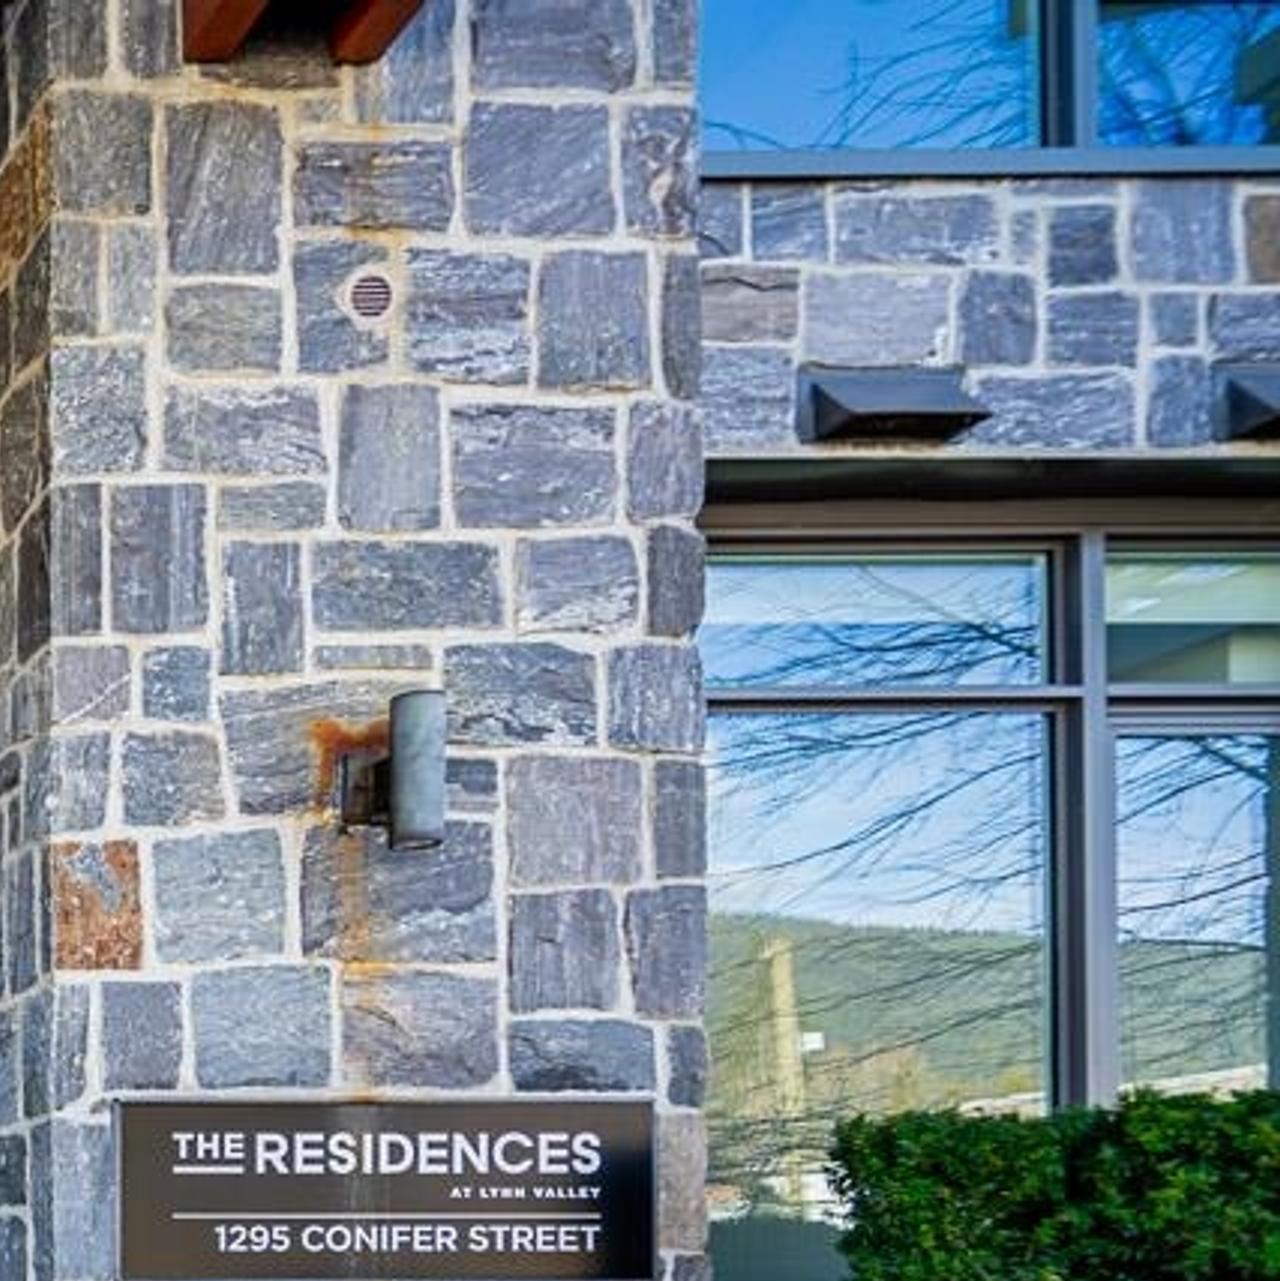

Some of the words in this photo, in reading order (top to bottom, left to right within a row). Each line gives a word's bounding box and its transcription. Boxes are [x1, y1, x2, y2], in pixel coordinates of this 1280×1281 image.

[172, 1132, 244, 1160] THE
[255, 1131, 601, 1175] RESIDENCES
[449, 1187, 472, 1199] AT
[532, 1187, 601, 1199] VALLEY
[214, 1224, 291, 1252] 1295
[301, 1224, 458, 1252] CONIFER
[469, 1224, 601, 1252] STREET
